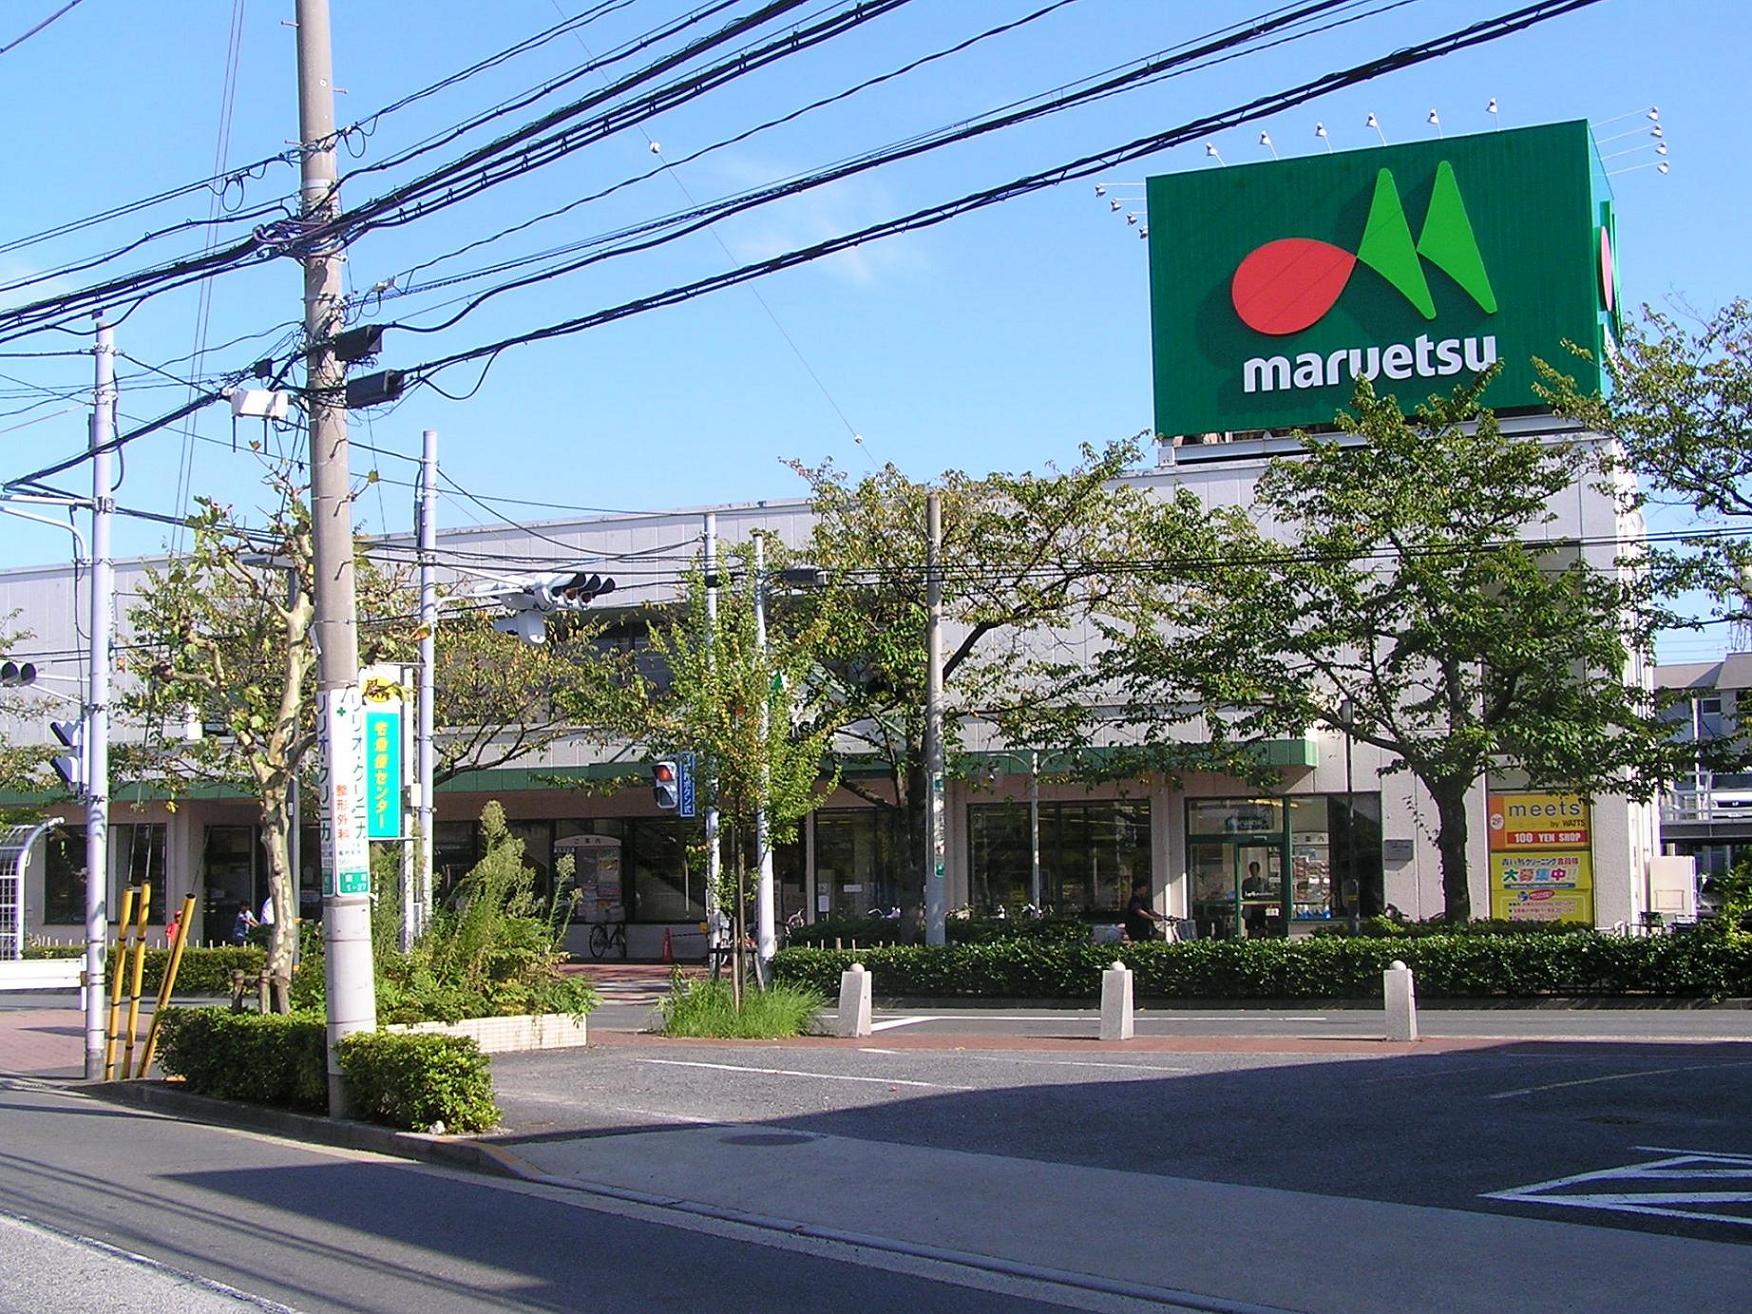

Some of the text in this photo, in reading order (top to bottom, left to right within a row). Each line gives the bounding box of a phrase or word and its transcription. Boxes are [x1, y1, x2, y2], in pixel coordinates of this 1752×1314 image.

[1243, 333, 1497, 393] maruetsu
[336, 784, 348, 841] 整形外科
[1508, 800, 1581, 817] meets
[1514, 832, 1581, 843] 100 YEN SHOP
